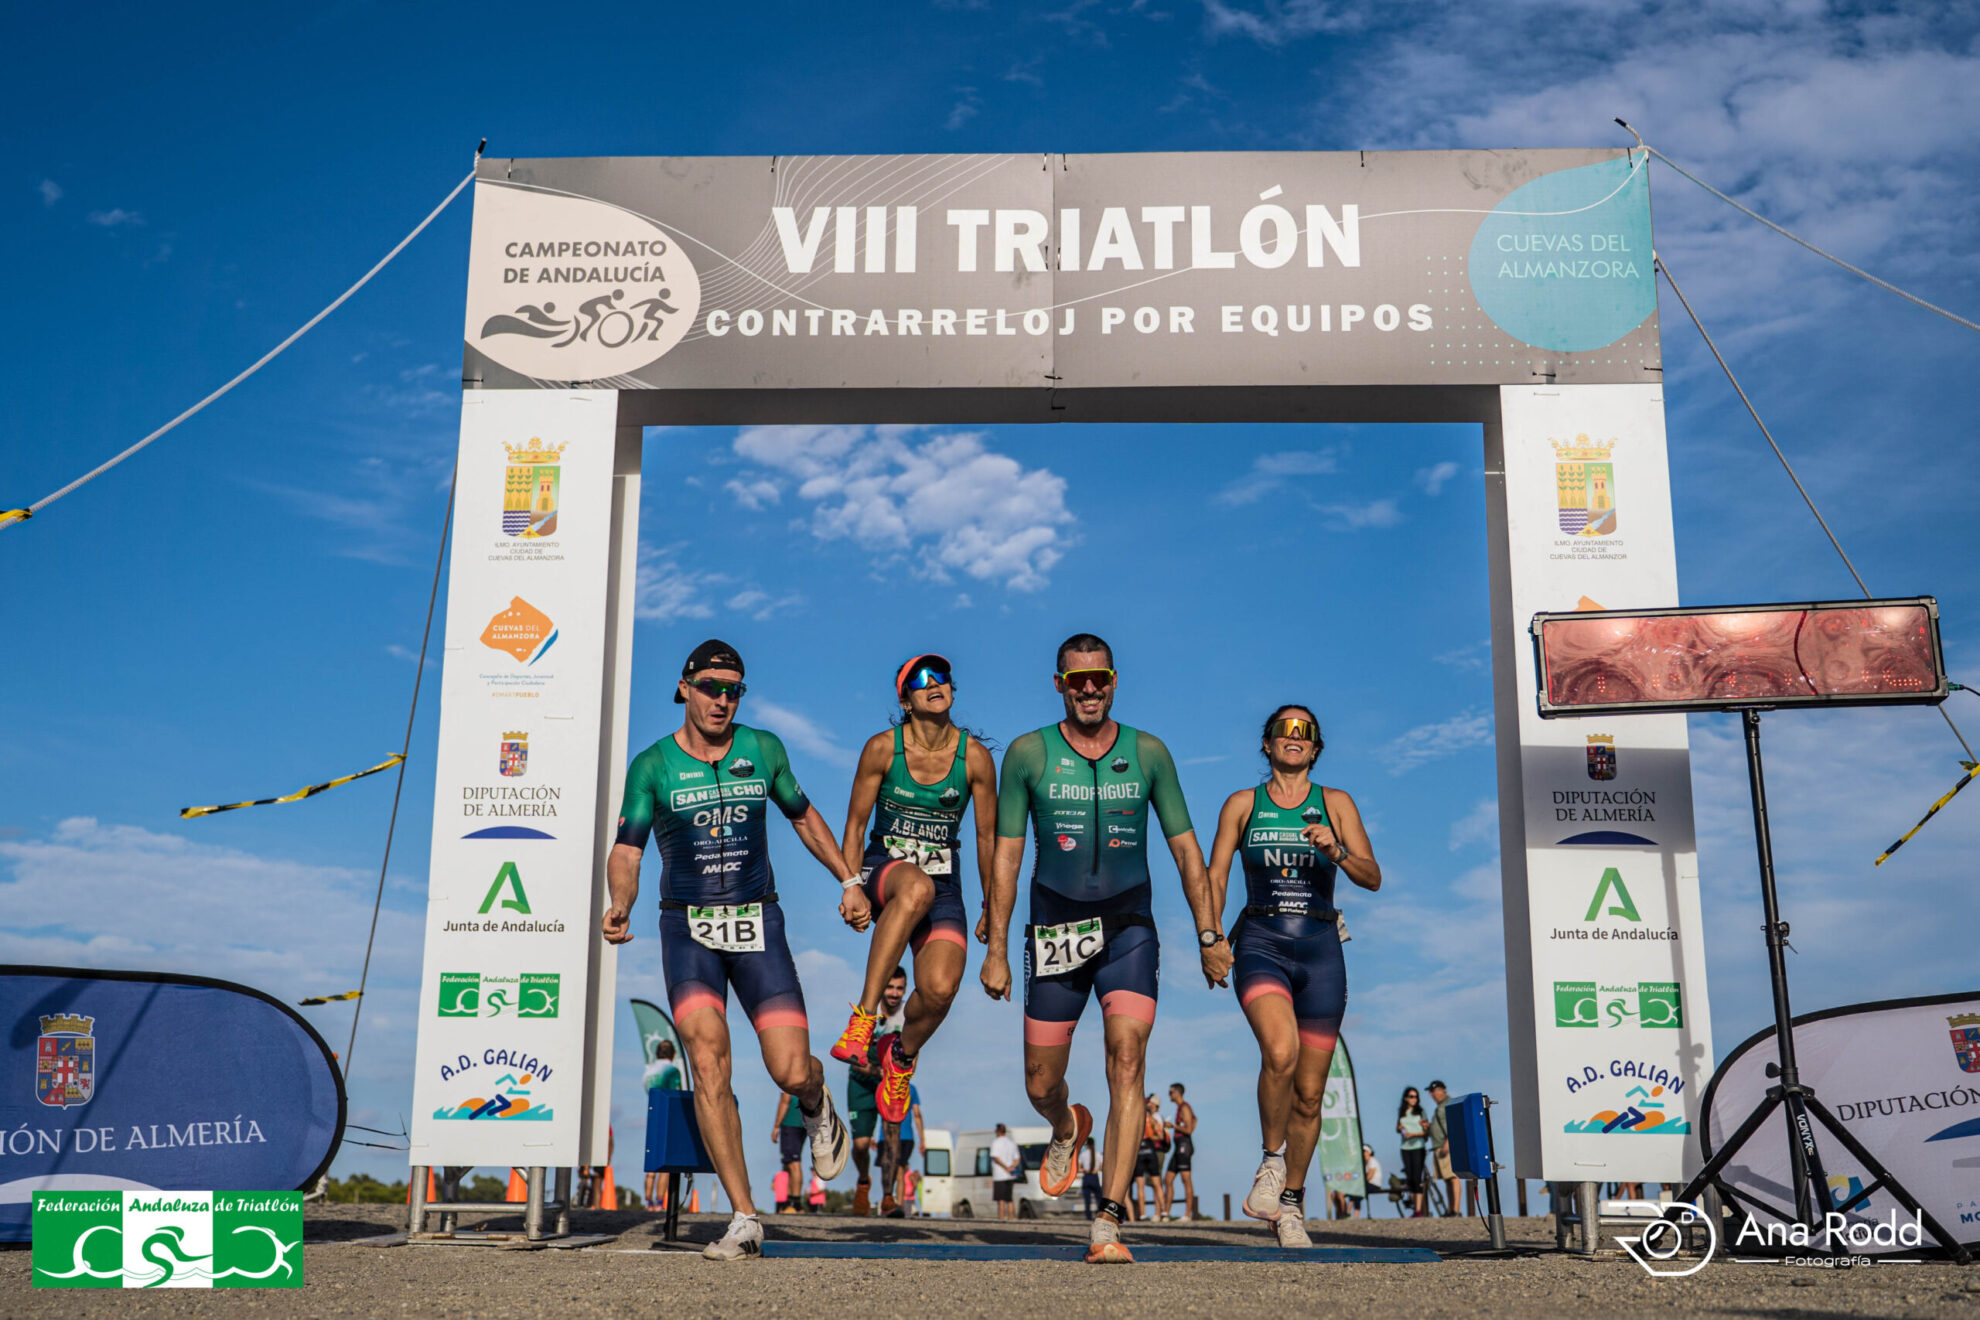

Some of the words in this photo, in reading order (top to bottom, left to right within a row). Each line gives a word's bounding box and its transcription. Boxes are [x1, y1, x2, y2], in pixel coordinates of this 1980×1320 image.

[771, 205, 918, 273] VIII
[946, 183, 1361, 272] TRIATLÓN
[504, 239, 667, 259] CAMPEONATO
[1495, 232, 1584, 253] CUEVAS
[1590, 232, 1632, 253] DEL
[502, 265, 532, 285] DE
[535, 260, 668, 285] ANDALUCÍA
[1497, 259, 1641, 280] ALMANZORA
[706, 308, 1076, 337] CONTRARRELOJ
[1100, 304, 1196, 335] POR
[1220, 302, 1435, 337] EQUIPOS
[492, 624, 524, 632] CUEVAS
[463, 785, 561, 800] DIPUTACIÓN
[676, 791, 709, 805] SAN
[733, 784, 764, 798] CHO
[1552, 788, 1656, 804] DIPUTACIÓN
[463, 804, 484, 816] DE
[487, 801, 558, 817] ALMERÍA
[1555, 809, 1577, 821] DE
[1582, 806, 1656, 822] ALMERÍA
[889, 817, 949, 840] A.BLANCO
[1253, 832, 1278, 841] SAN
[694, 848, 749, 861] Pedamoto
[1263, 849, 1315, 867] Nuri
[442, 920, 479, 932] Junta
[482, 920, 499, 932] de
[501, 919, 565, 933] Andalucía
[697, 921, 756, 943] 21B
[1550, 928, 1589, 940] Junta
[1592, 928, 1609, 940] de
[1611, 926, 1679, 941] Andalucía
[1043, 935, 1097, 967] 21C
[442, 975, 480, 984] Federación
[1555, 984, 1596, 993] Federación
[440, 1055, 477, 1081] A.D.
[483, 1049, 553, 1082] GALIAN
[1566, 1065, 1604, 1094] A.D.
[1610, 1060, 1686, 1095] GALIAN
[73, 1128, 116, 1153] DE
[125, 1114, 267, 1150] ALMERÍA
